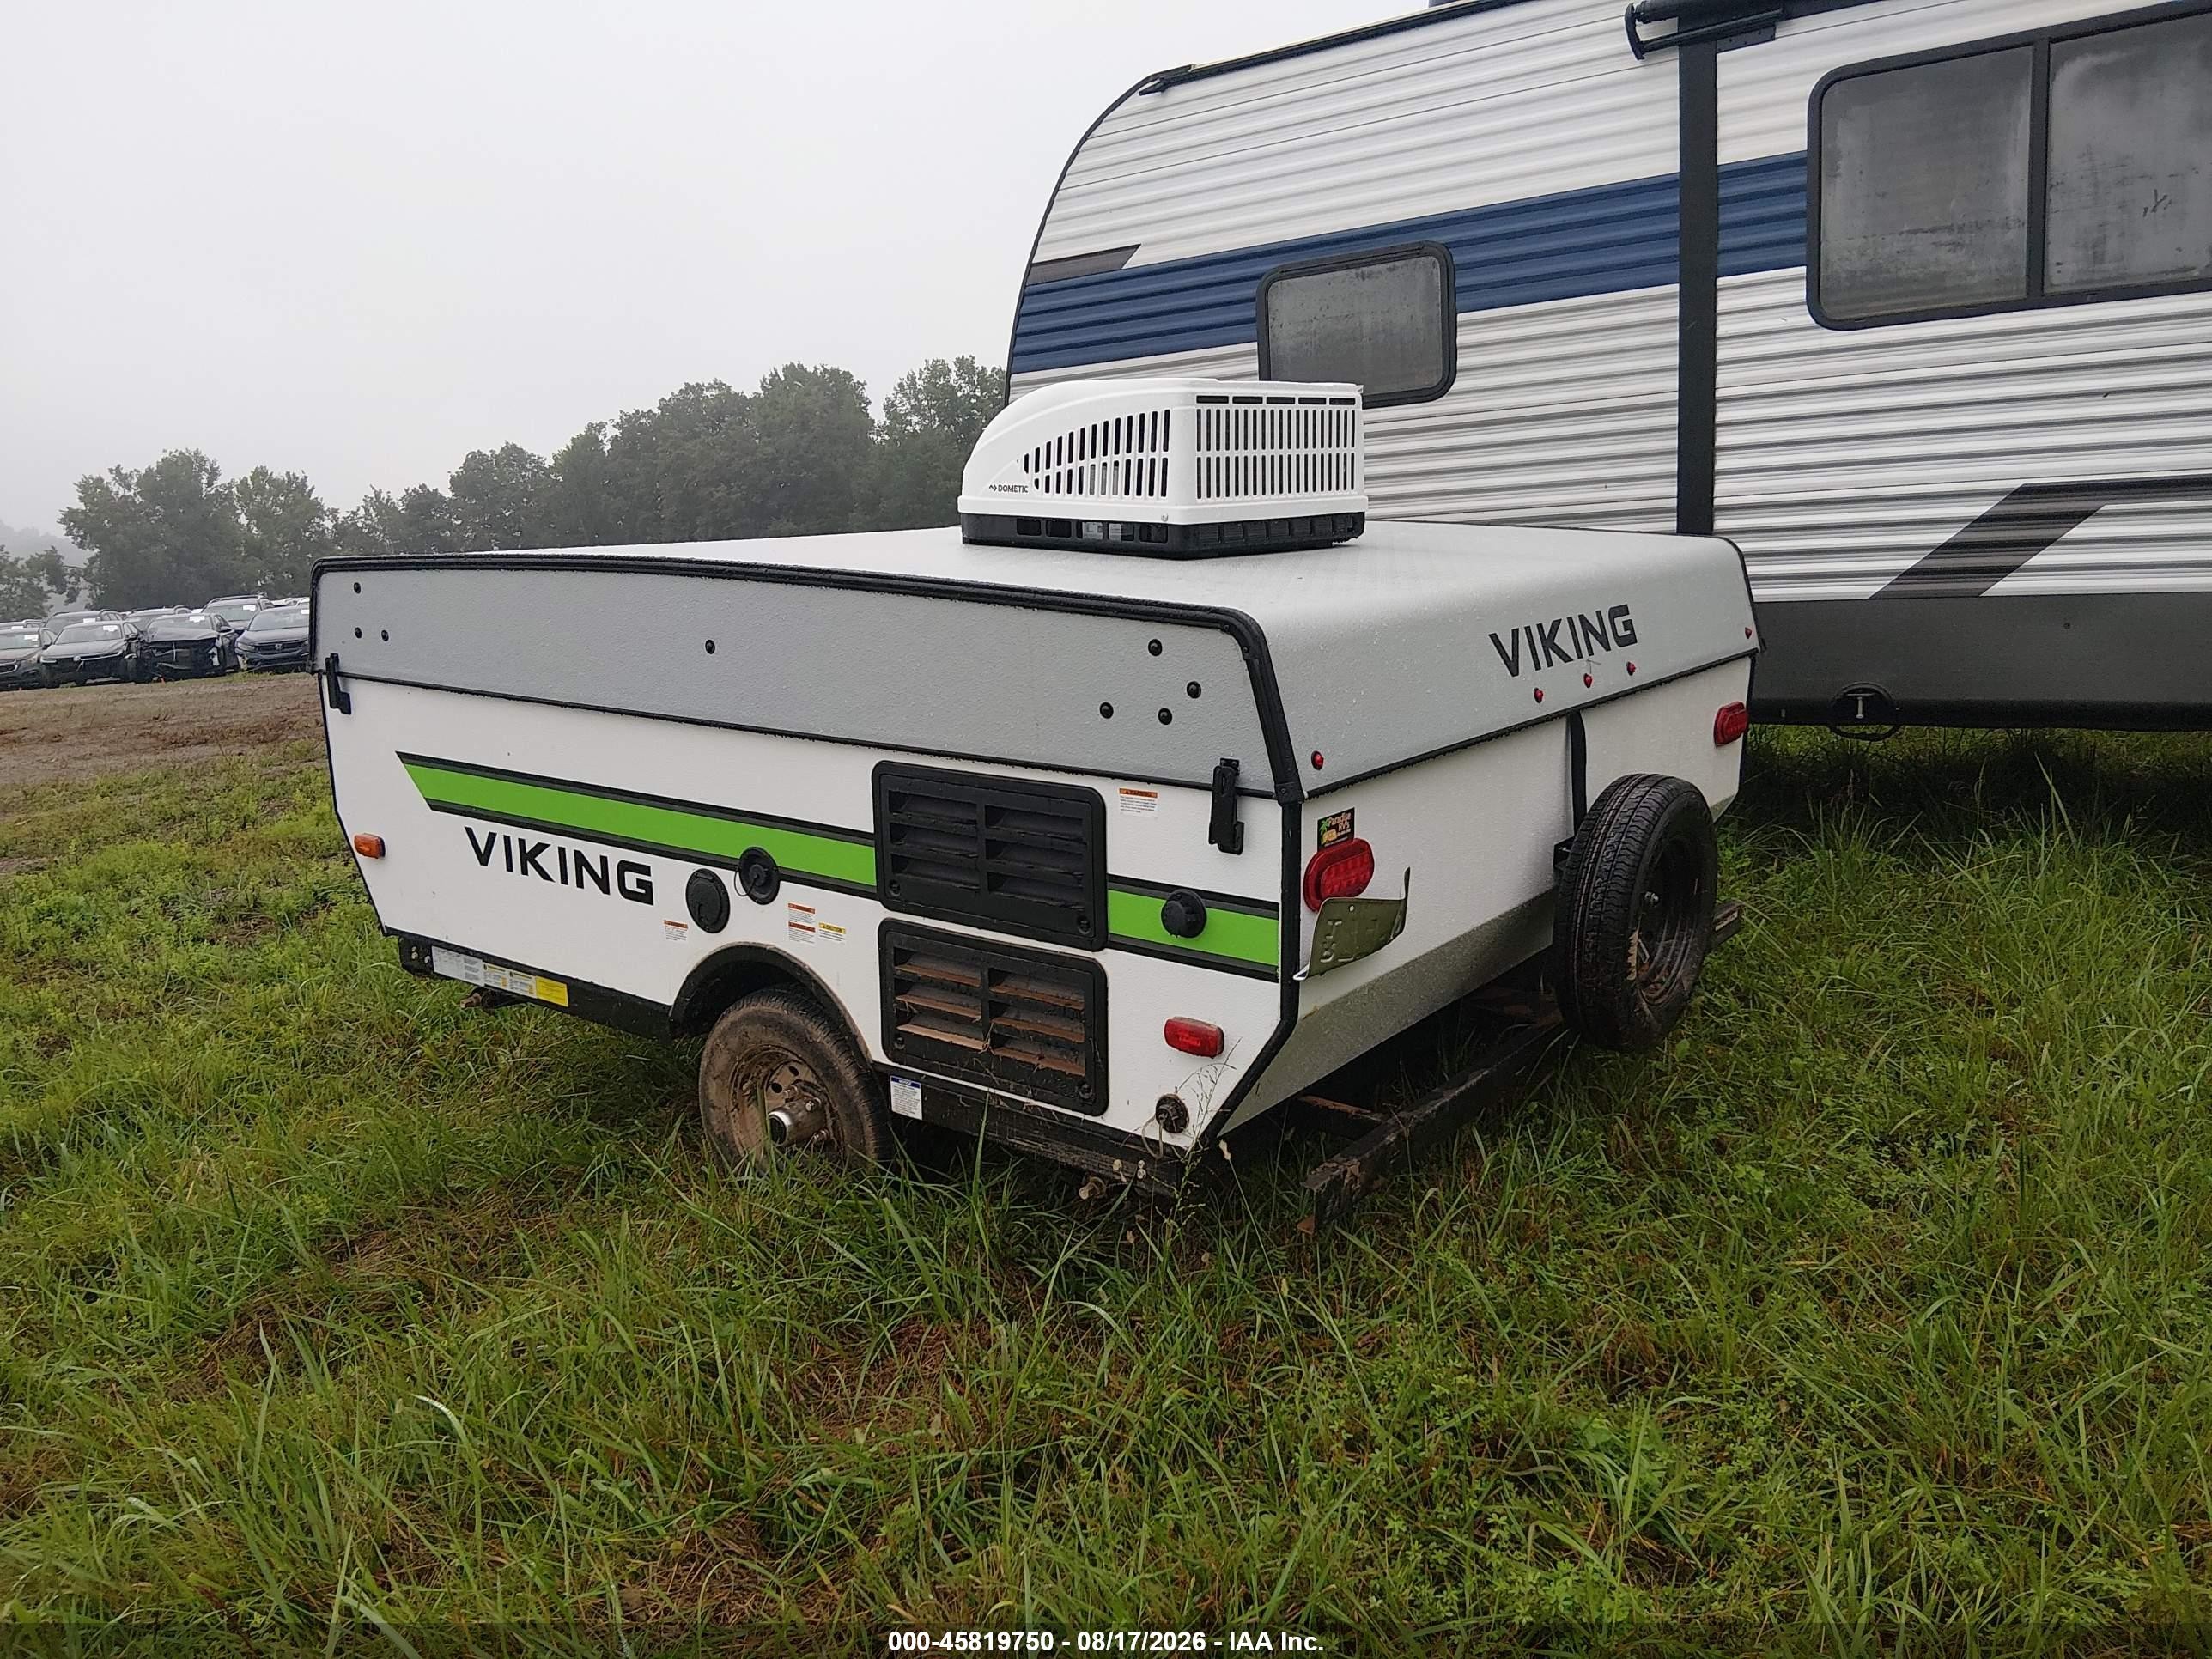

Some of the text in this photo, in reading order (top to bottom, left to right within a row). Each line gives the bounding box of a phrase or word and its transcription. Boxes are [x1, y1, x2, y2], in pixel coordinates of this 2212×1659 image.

[998, 484, 1029, 493] DOMETIC
[1488, 604, 1638, 678] VIKING
[464, 826, 654, 906] VIKING
